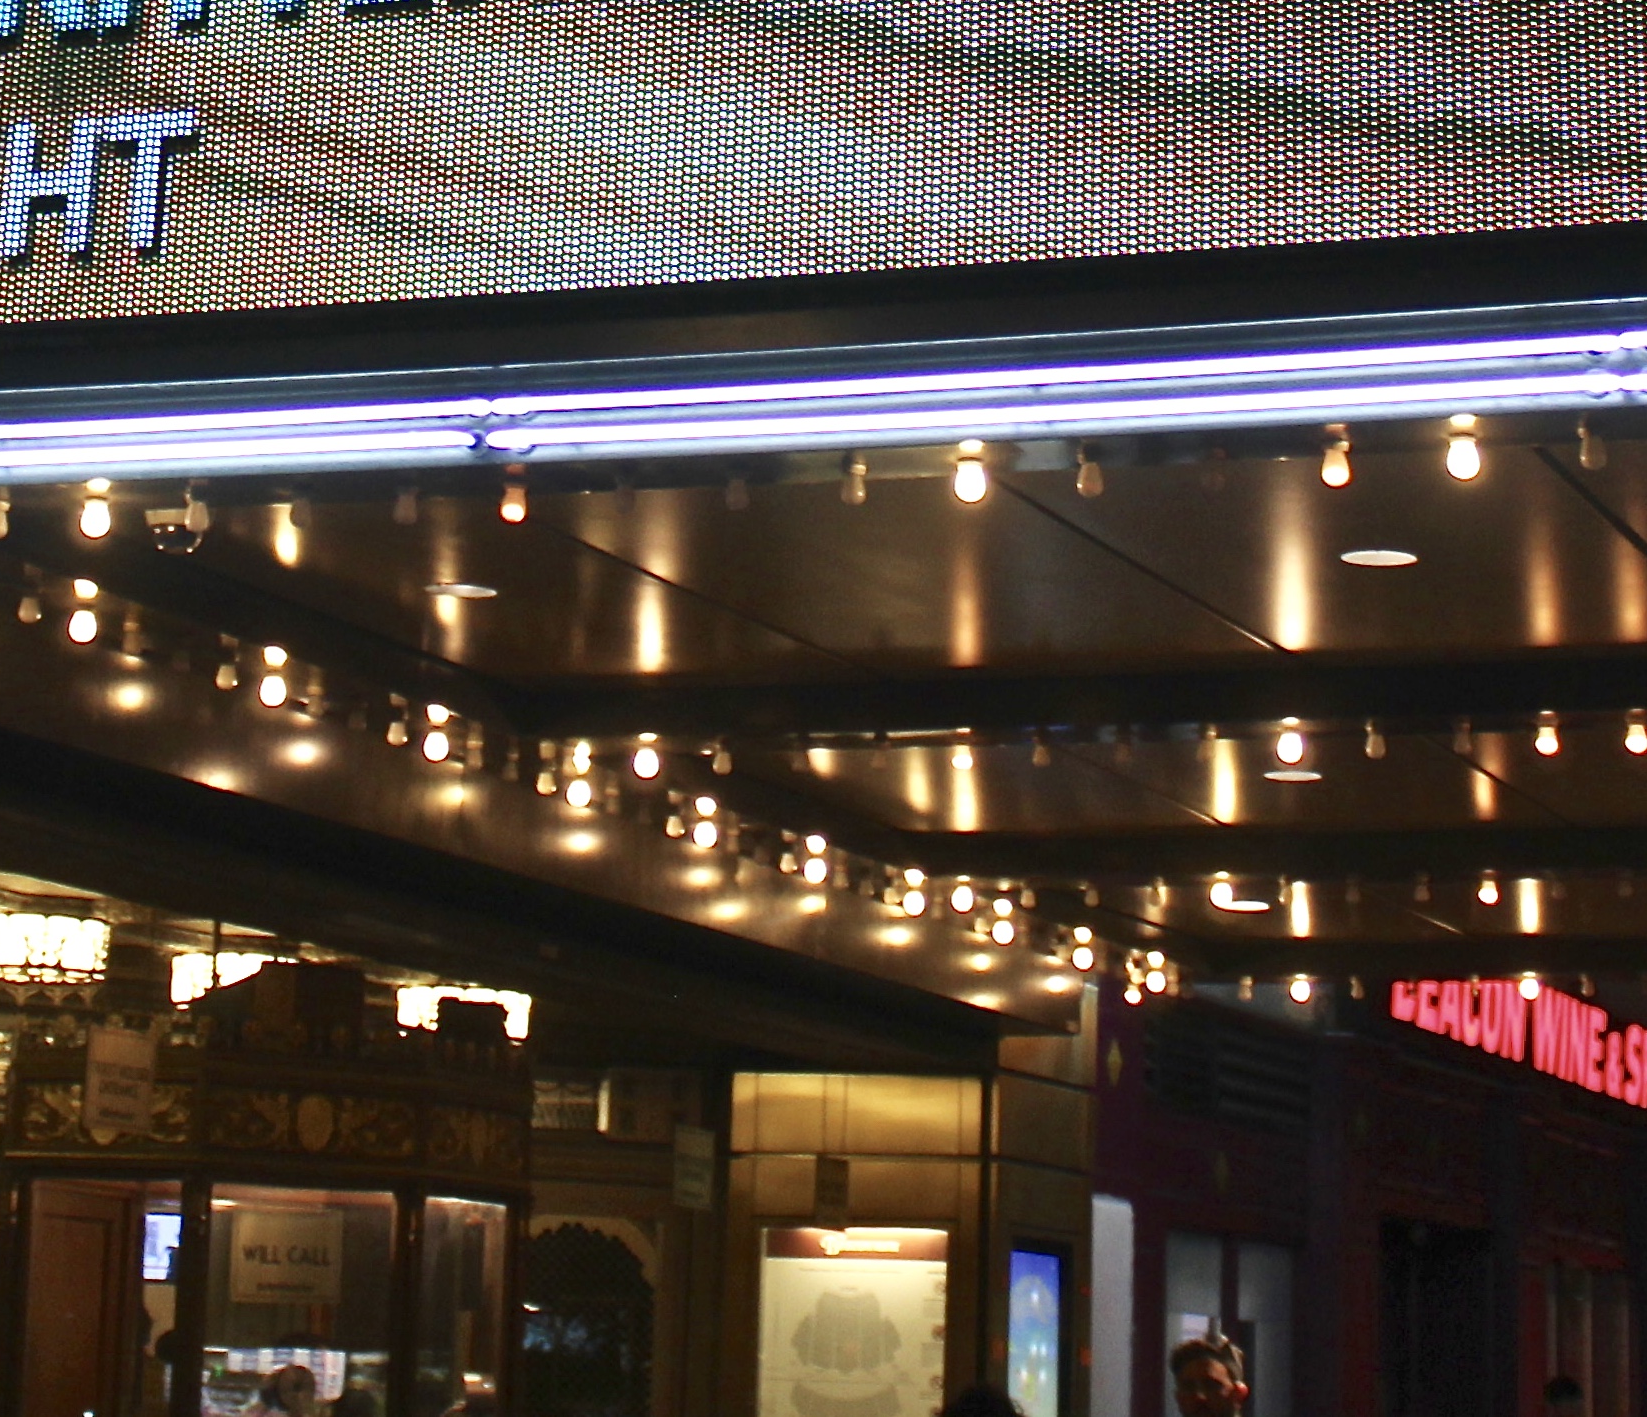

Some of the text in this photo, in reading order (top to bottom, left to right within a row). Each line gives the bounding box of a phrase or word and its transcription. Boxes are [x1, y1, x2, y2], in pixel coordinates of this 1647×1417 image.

[1532, 985, 1609, 1094] WINE
[1606, 1030, 1624, 1101] &
[242, 1243, 330, 1267] WILL CALL
